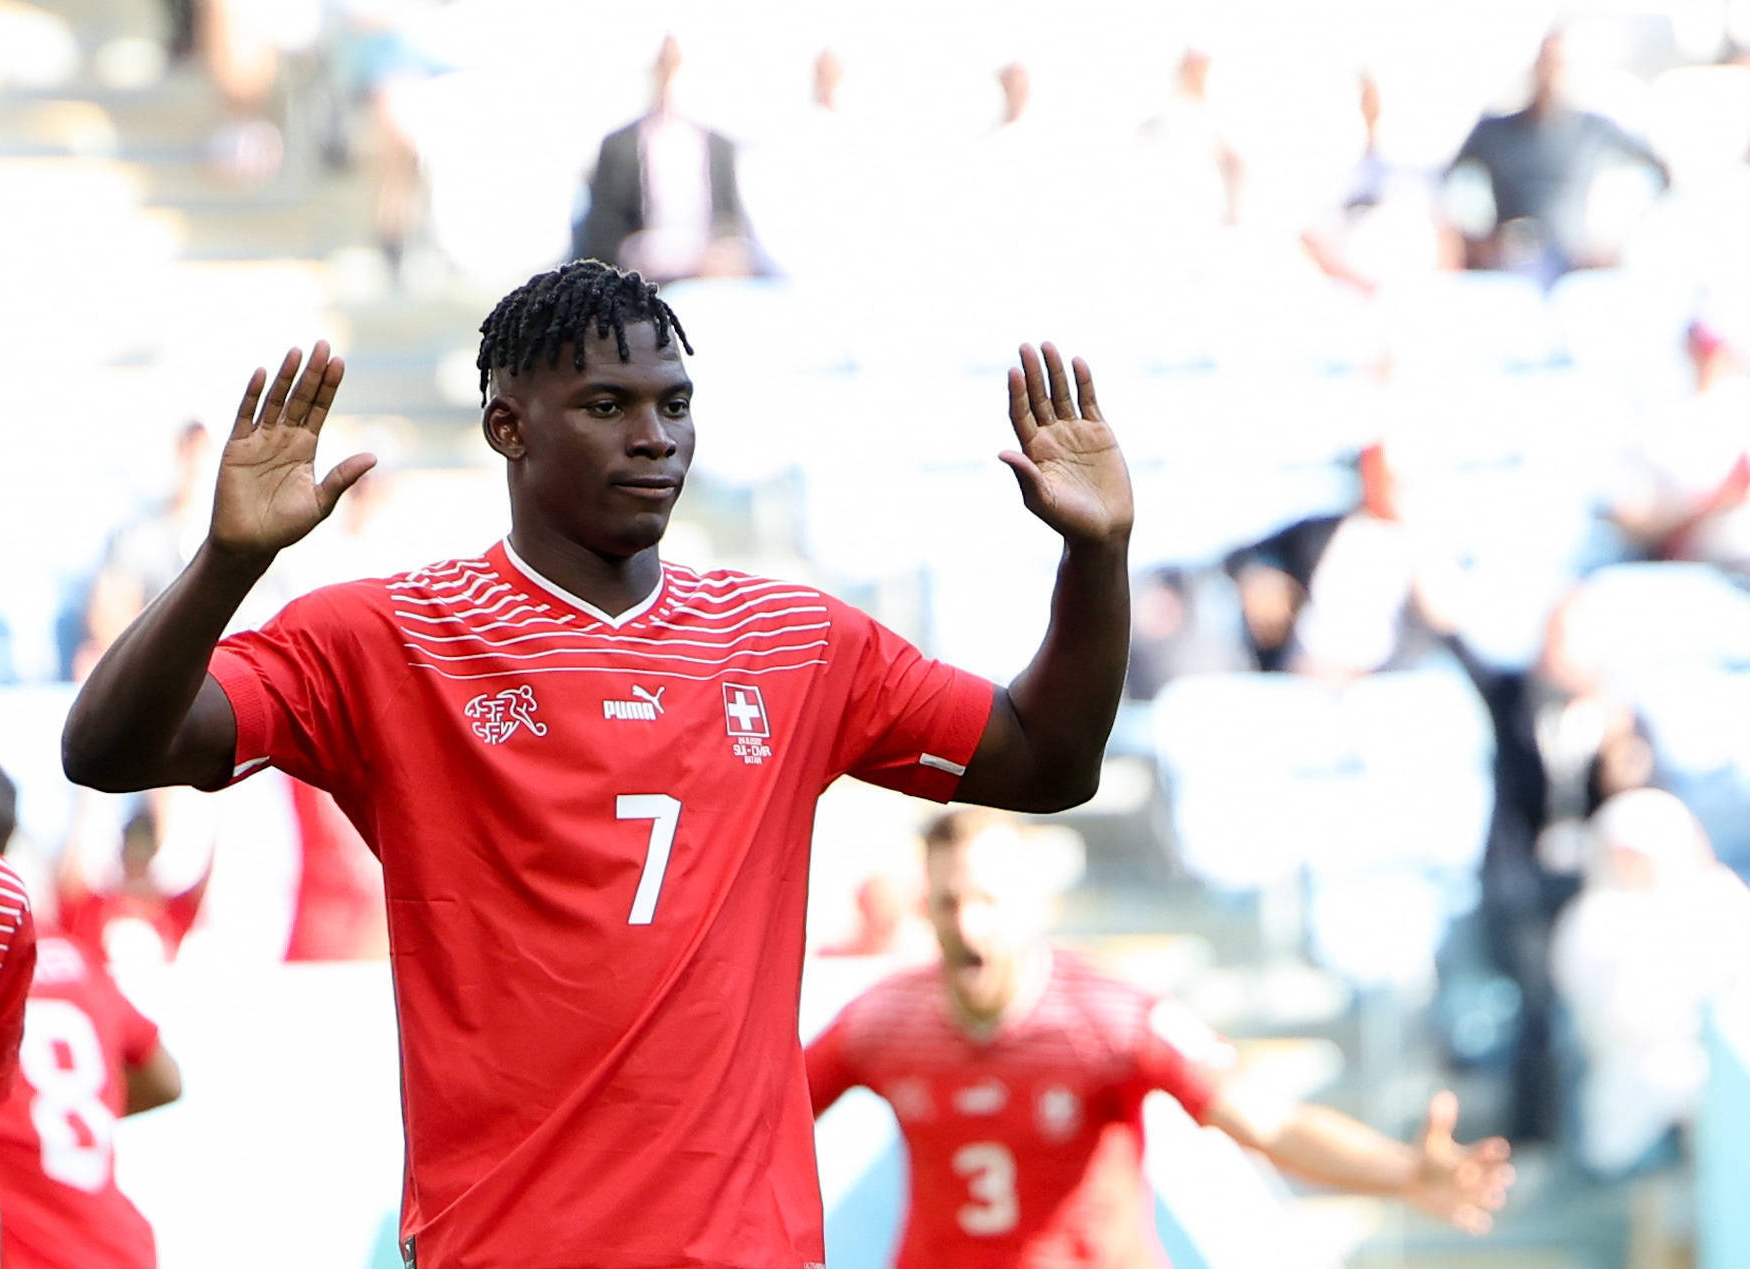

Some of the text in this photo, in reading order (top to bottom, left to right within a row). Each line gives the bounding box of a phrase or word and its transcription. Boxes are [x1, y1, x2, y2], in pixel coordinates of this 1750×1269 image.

[602, 699, 657, 721] PUMA
[615, 793, 683, 926] 7
[19, 997, 115, 1194] 8
[952, 1140, 1021, 1237] 3
